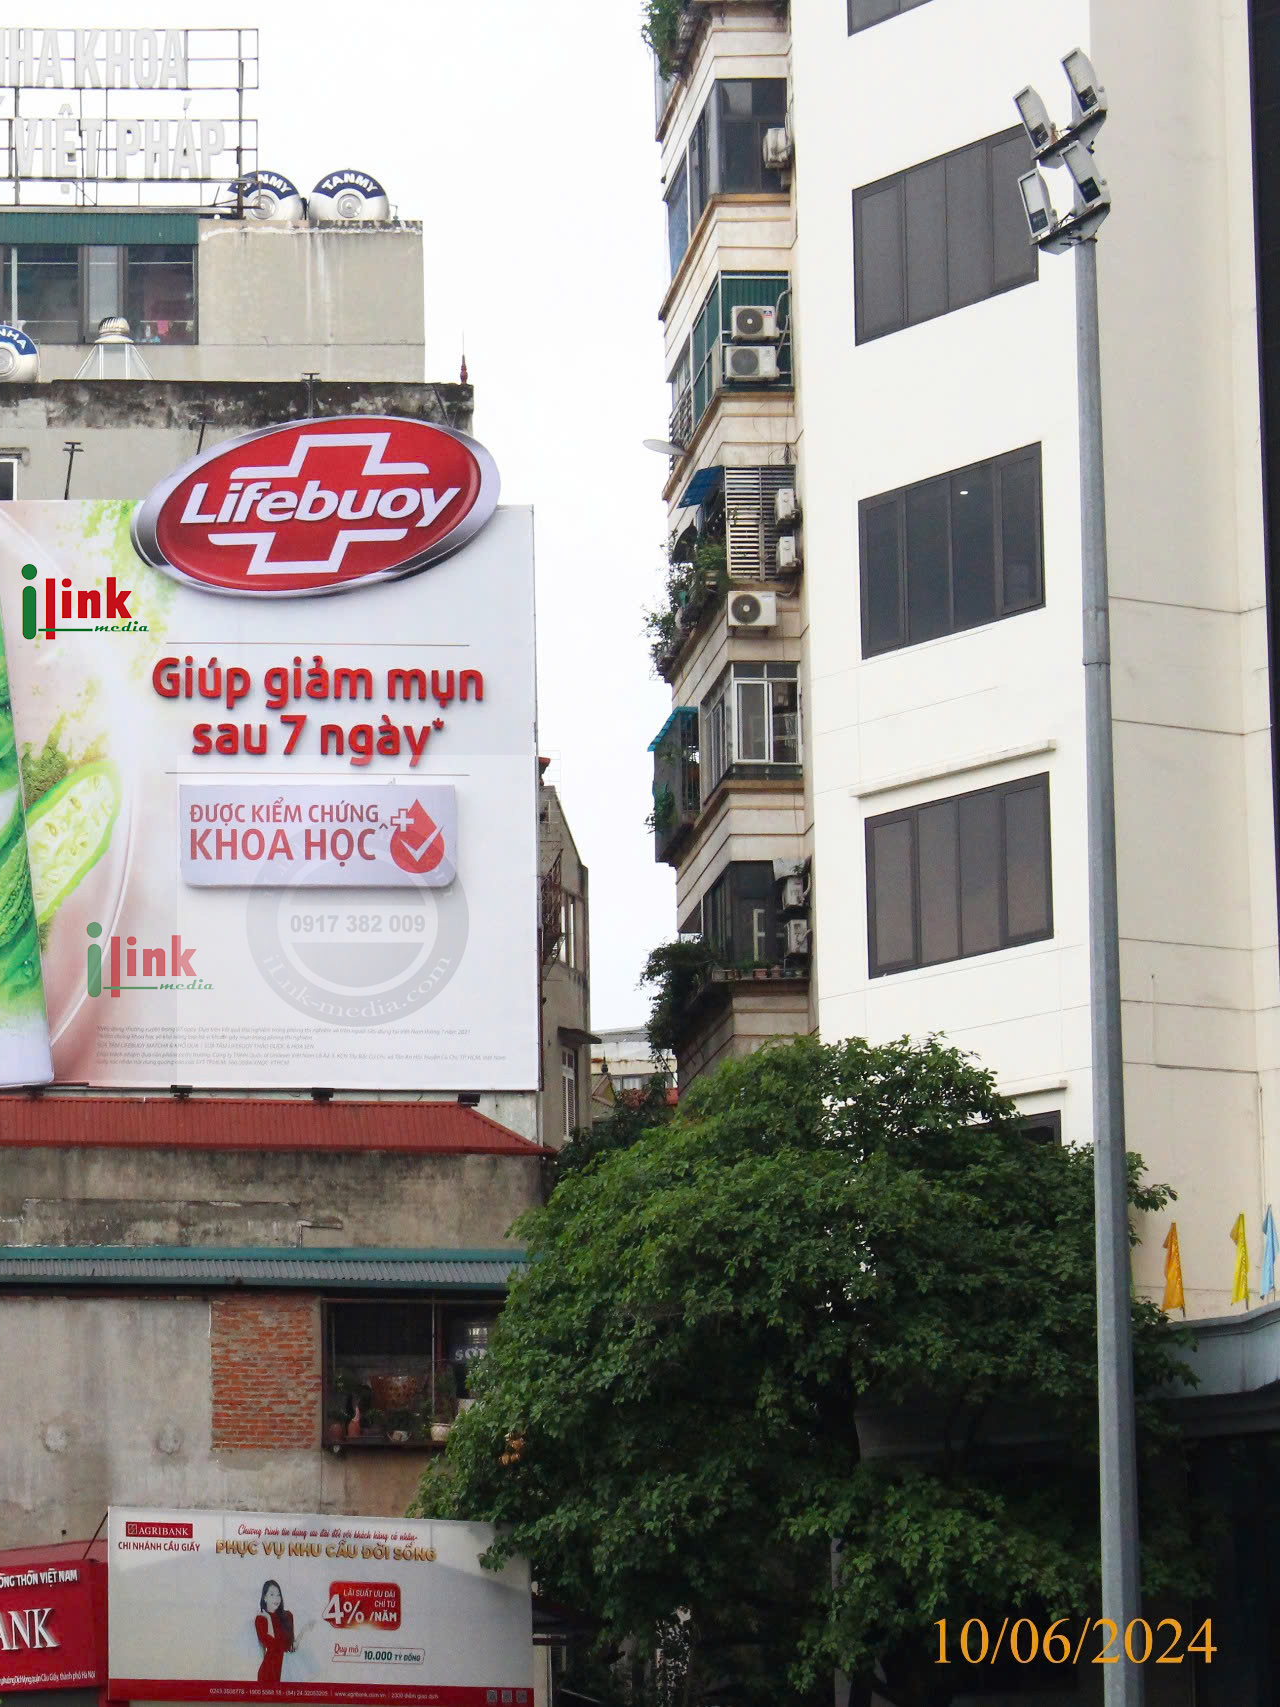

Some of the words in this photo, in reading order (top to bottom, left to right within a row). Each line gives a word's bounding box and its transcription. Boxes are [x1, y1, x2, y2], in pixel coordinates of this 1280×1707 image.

[74, 28, 187, 89] KHOA
[116, 98, 225, 179] PHÁP
[321, 172, 378, 193] TANMY
[180, 480, 461, 528] Lifebuoy
[152, 655, 251, 710] Giúp
[264, 655, 372, 710] giảm
[387, 668, 484, 708] mụn
[192, 722, 267, 756] sau
[280, 714, 307, 756] 7
[190, 802, 246, 827] ĐƯỢC
[252, 796, 303, 823] KIỂM
[308, 800, 379, 823] CHỨNG
[190, 828, 295, 861] KHOA
[138, 1526, 189, 1537] AGRIBANK
[118, 1541, 131, 1550] CHI
[132, 1540, 161, 1551] NHÁNH
[163, 1540, 180, 1552] CẦU
[182, 1541, 200, 1552] GIẤY
[216, 1540, 258, 1558] PHỤC
[262, 1541, 285, 1559] VỤ
[288, 1543, 320, 1558] NHU
[325, 1539, 357, 1559] CẦU
[361, 1542, 390, 1560] ĐỜI
[393, 1541, 437, 1562] SỐNG
[15, 1569, 38, 1586] THÔN
[40, 1568, 58, 1588] VIỆT
[58, 1569, 78, 1582] NAM
[322, 1593, 365, 1625] 4%
[369, 1609, 397, 1622] /NĂM
[334, 1643, 347, 1657] Quy
[364, 1650, 392, 1661] 10.000
